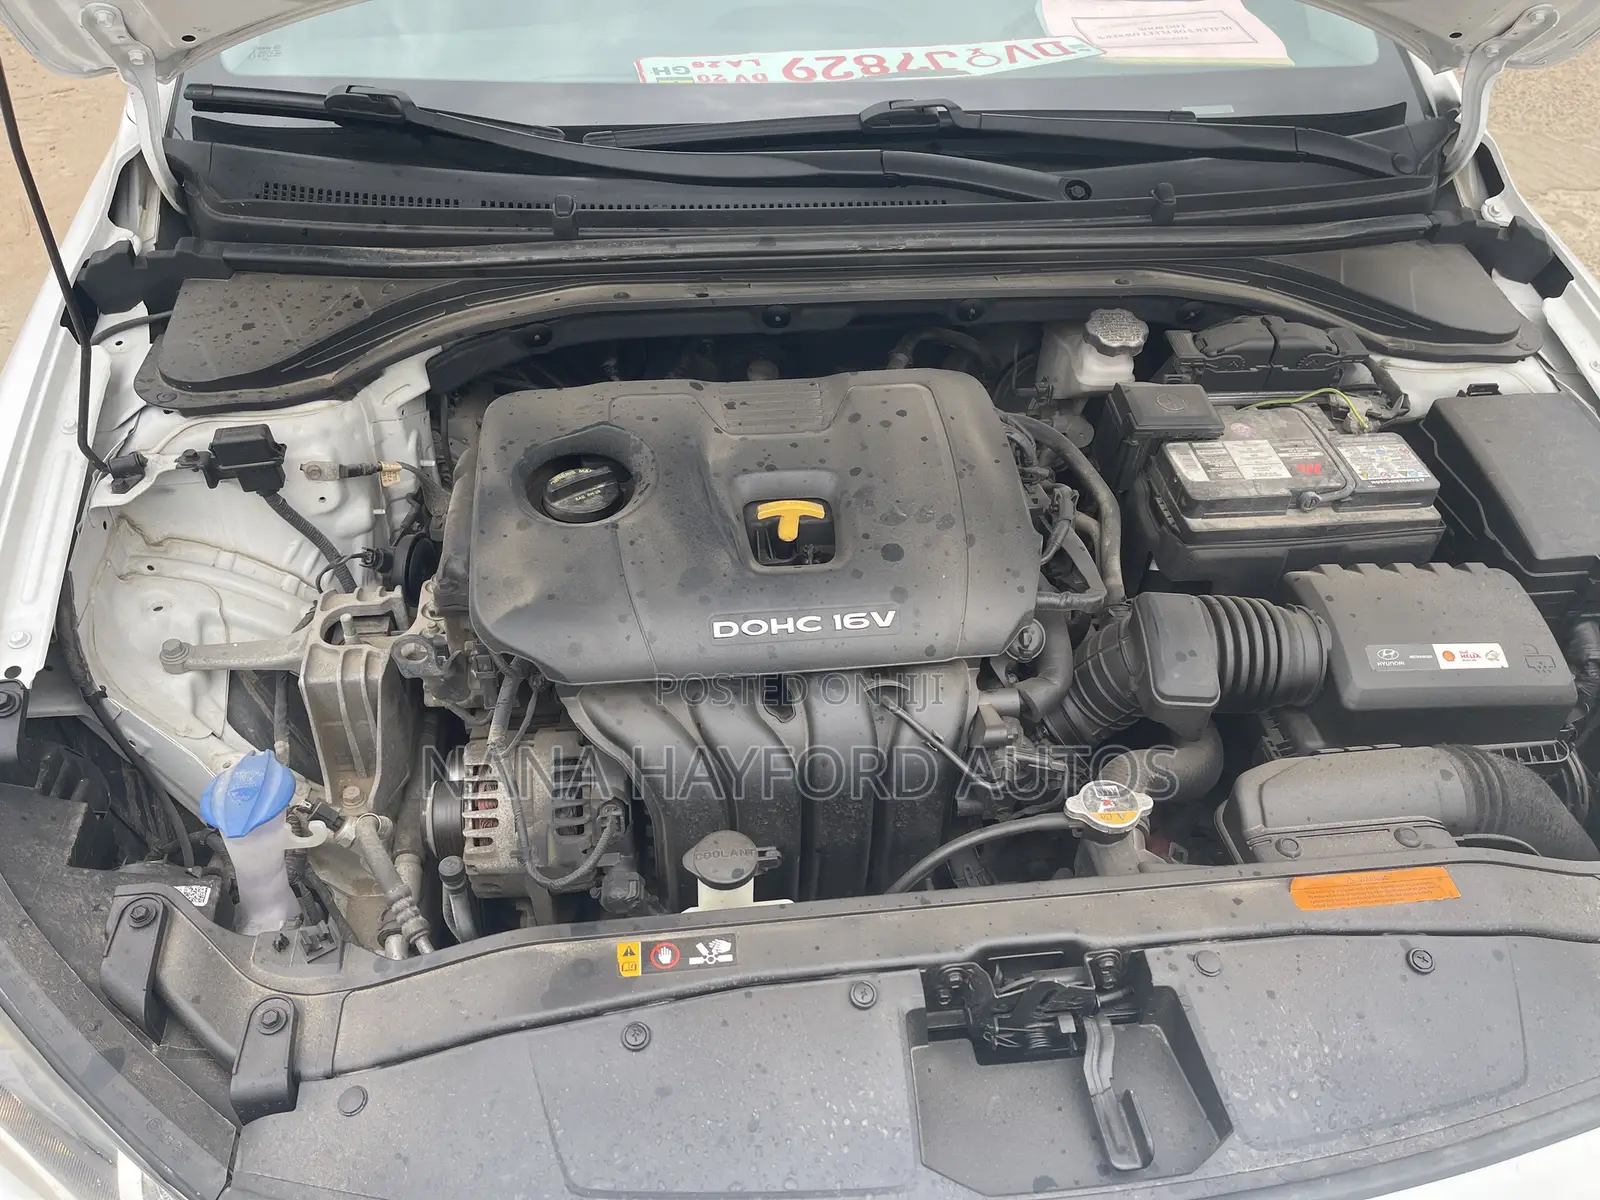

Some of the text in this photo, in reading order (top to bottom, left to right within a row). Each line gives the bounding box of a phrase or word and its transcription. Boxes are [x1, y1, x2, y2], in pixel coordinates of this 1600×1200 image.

[652, 66, 691, 76] GH
[781, 41, 1077, 82] DV J7829
[712, 610, 896, 640] DOHC 16V
[695, 848, 757, 861] COOLANT
